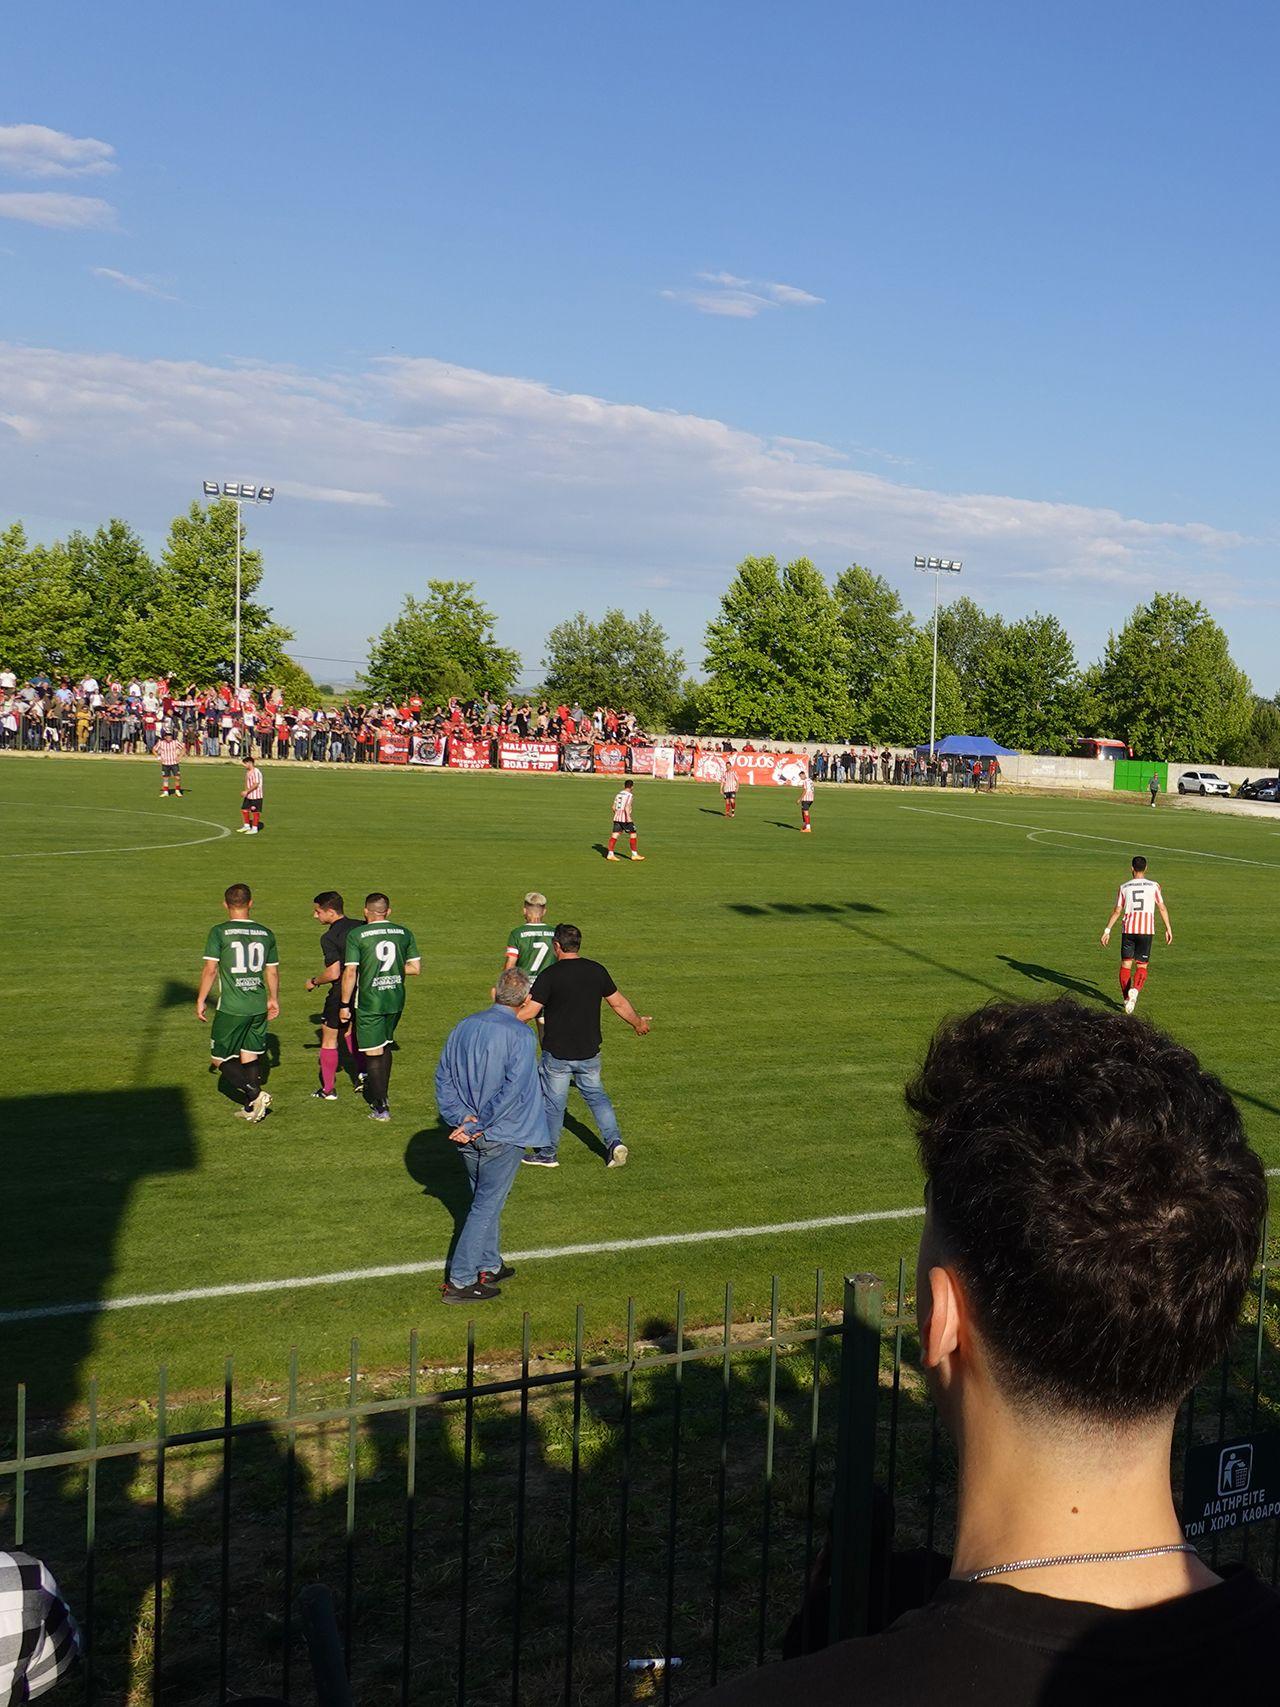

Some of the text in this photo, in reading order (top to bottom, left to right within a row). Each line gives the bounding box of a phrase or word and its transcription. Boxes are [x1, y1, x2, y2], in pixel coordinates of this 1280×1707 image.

[502, 742, 557, 752] MALAVETAS
[503, 760, 554, 770] ROAD TRIP
[747, 770, 755, 785] 1
[1132, 890, 1144, 910] 5
[230, 941, 265, 973] 10
[375, 940, 396, 972] 9
[530, 942, 549, 972] 7
[1203, 1489, 1266, 1517] ΔΙΑΤΗΡΕΙΤΕ
[1184, 1520, 1205, 1538] ΤΟΝ
[1210, 1512, 1237, 1531] ΧΩΡΟ
